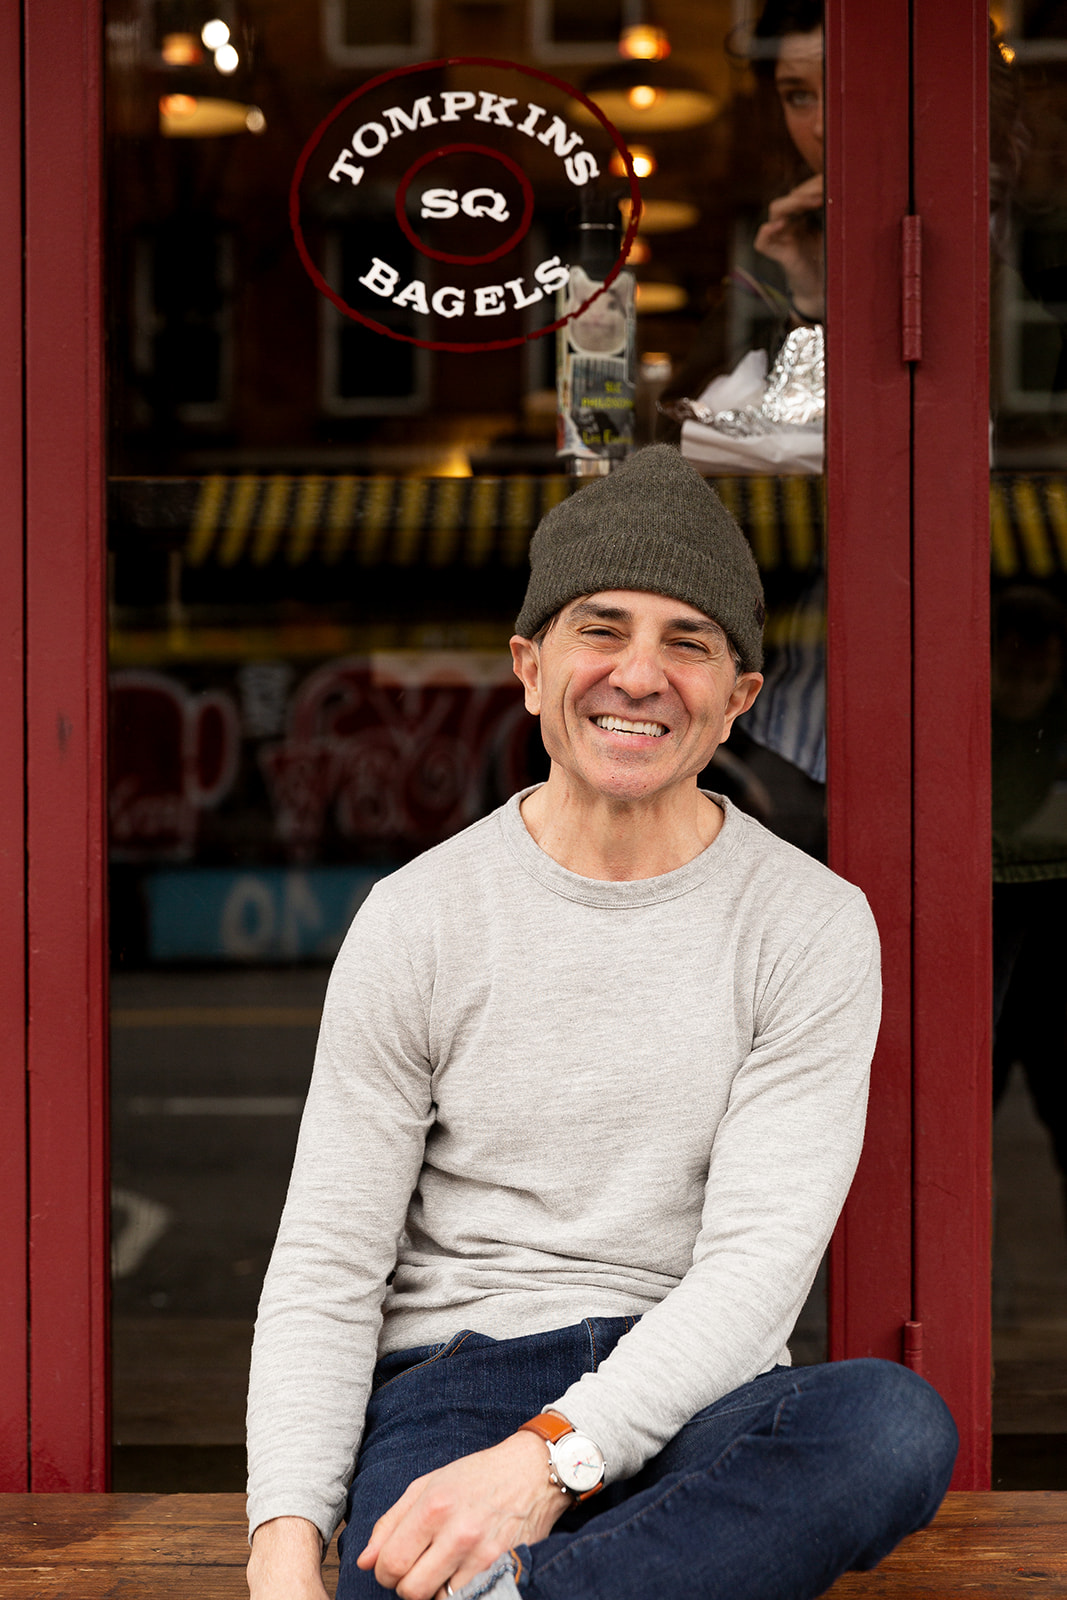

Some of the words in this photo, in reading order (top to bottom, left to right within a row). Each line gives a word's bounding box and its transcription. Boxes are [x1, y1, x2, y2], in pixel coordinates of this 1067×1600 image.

[328, 91, 600, 186] TOMPKINS
[420, 188, 510, 222] SQ
[358, 255, 570, 318] BAGELS
